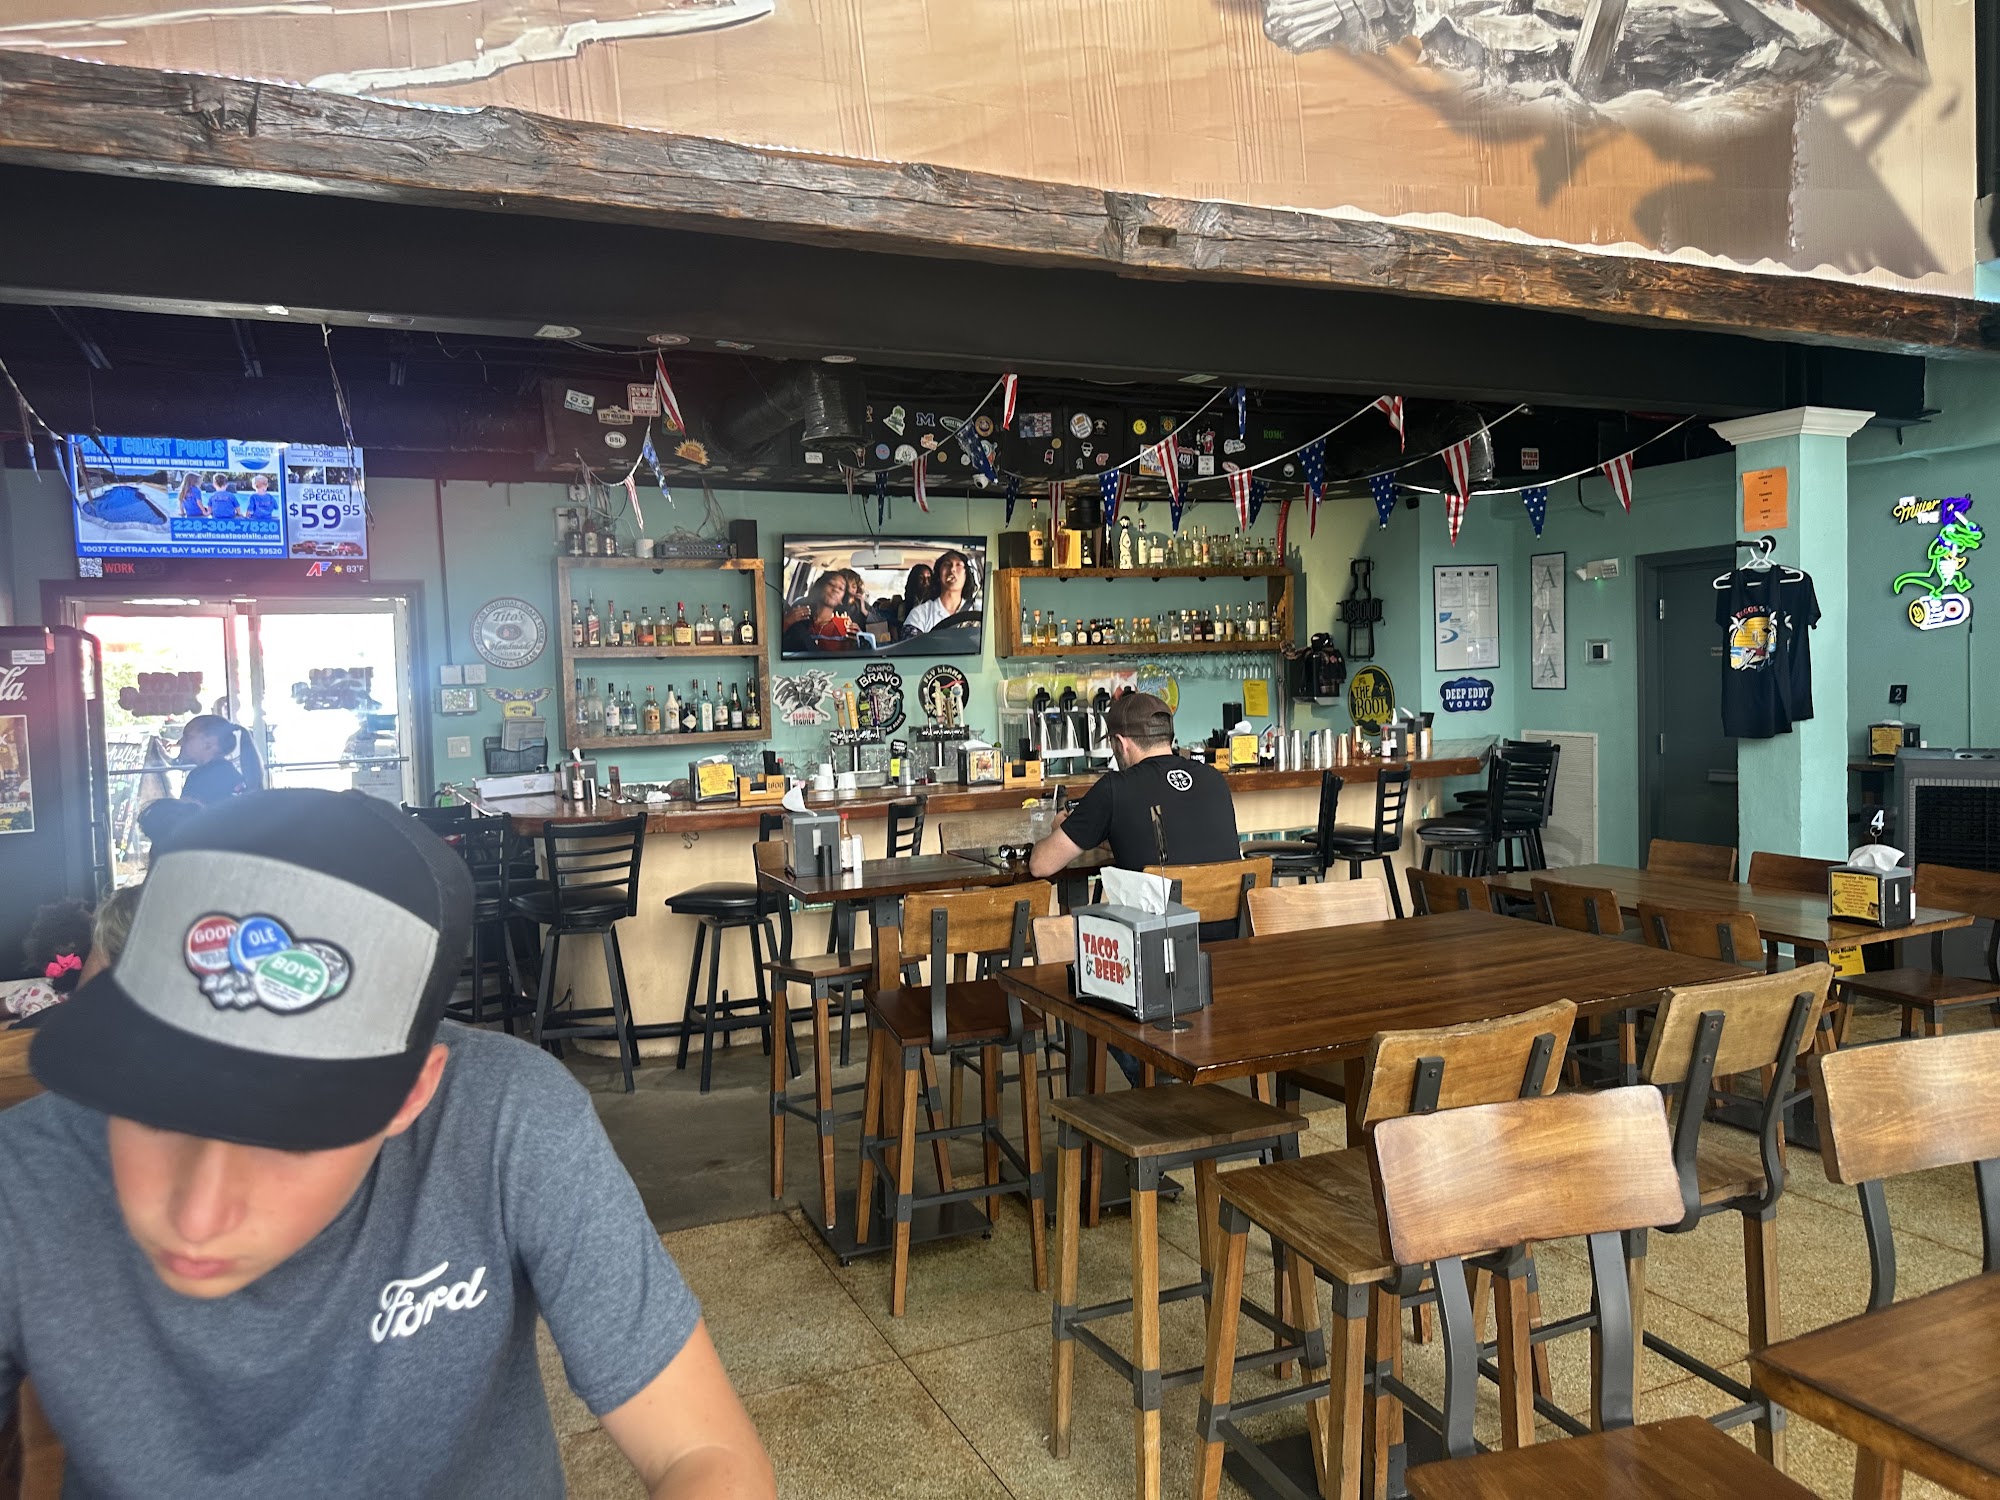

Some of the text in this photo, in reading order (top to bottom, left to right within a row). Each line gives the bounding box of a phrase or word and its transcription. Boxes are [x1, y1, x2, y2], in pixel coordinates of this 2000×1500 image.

[121, 438, 172, 456] COAST
[176, 440, 225, 458] POOLS
[173, 520, 279, 532] 228-304-7520
[104, 563, 135, 573] WORK
[859, 672, 900, 687] BRAVO
[1355, 685, 1372, 698] THE
[1445, 687, 1489, 700] DEEP EDDY
[1895, 688, 1903, 701] 2
[1449, 700, 1487, 708] VODKA
[1870, 809, 1885, 830] 4
[249, 927, 278, 946] OLE
[1083, 932, 1119, 961] TACOS
[271, 956, 322, 983] BOYS
[1094, 957, 1125, 986] BEER
[371, 1261, 488, 1342] Ford
